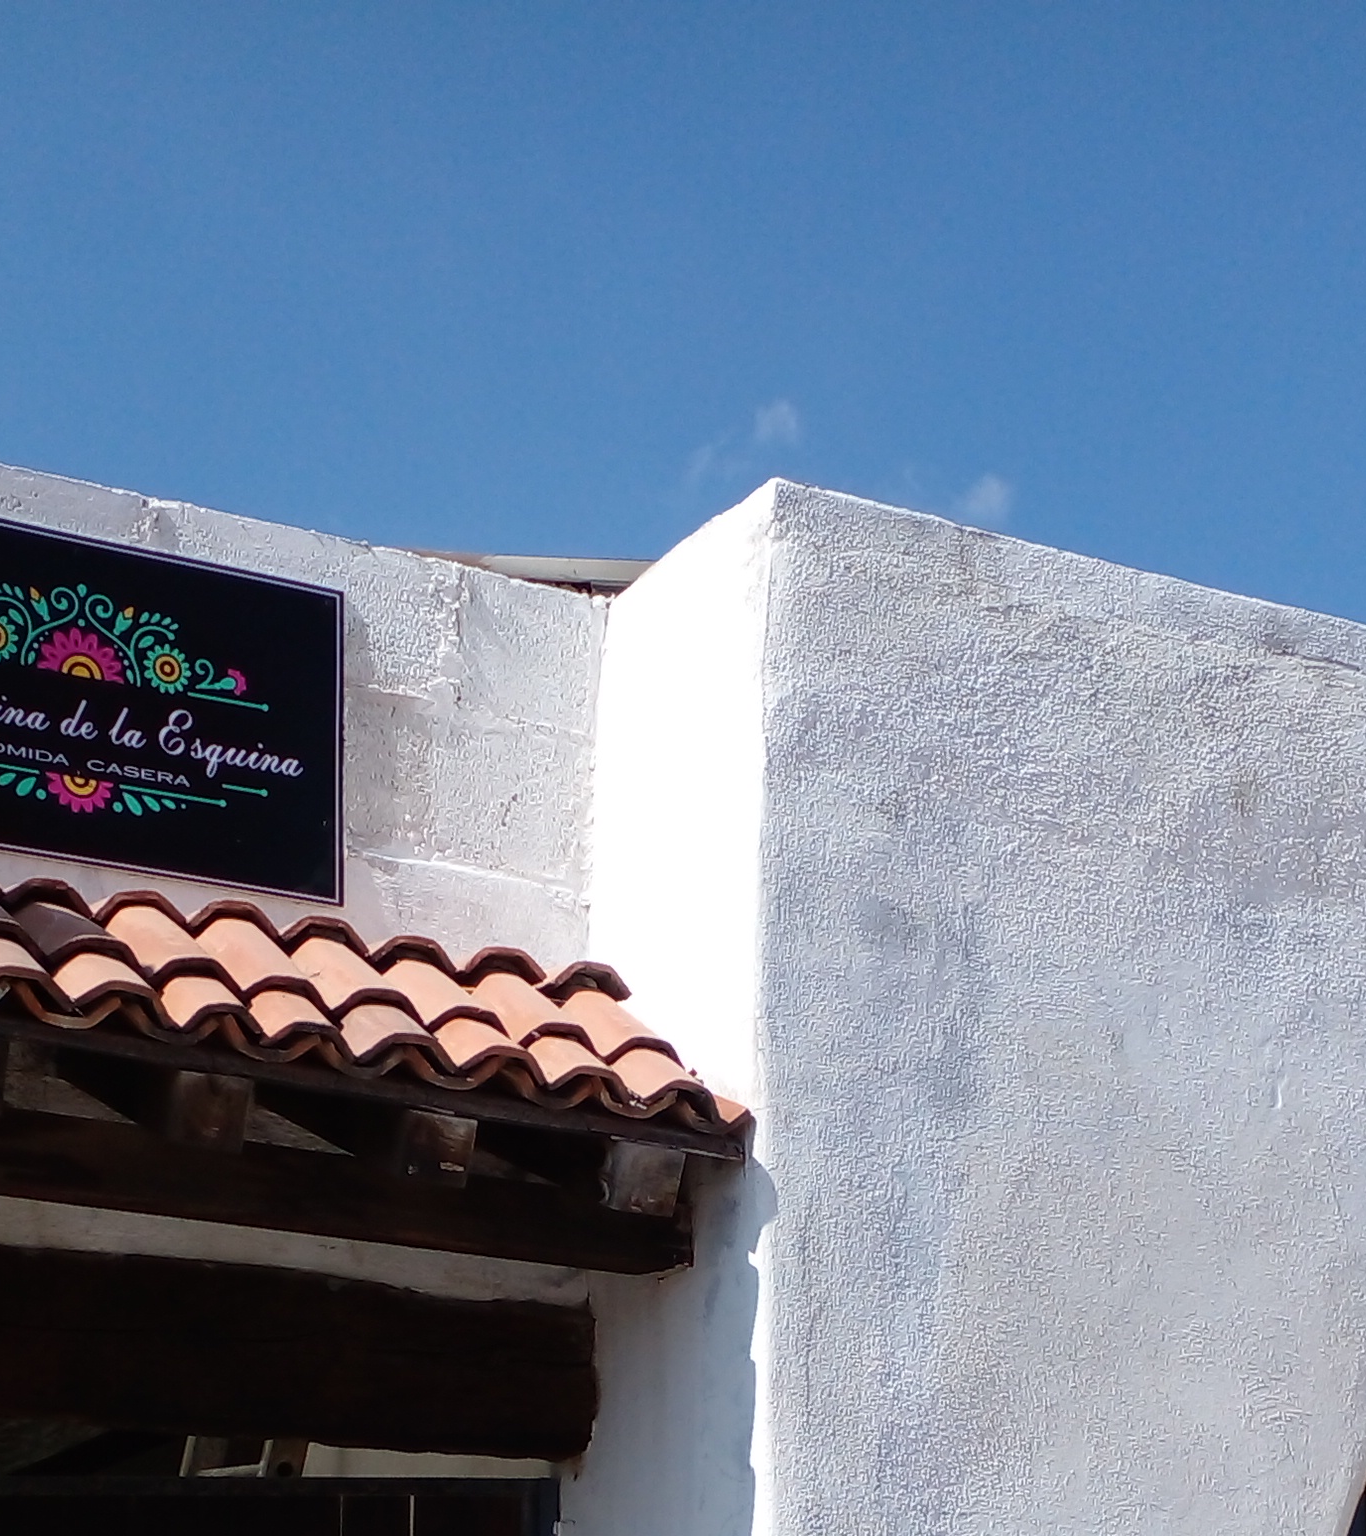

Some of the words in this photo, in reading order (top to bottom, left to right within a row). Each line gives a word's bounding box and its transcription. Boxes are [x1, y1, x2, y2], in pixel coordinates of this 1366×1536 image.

[60, 700, 98, 741] de
[109, 706, 147, 750] la
[158, 708, 304, 778] Esquina
[86, 758, 190, 788] CASERA
